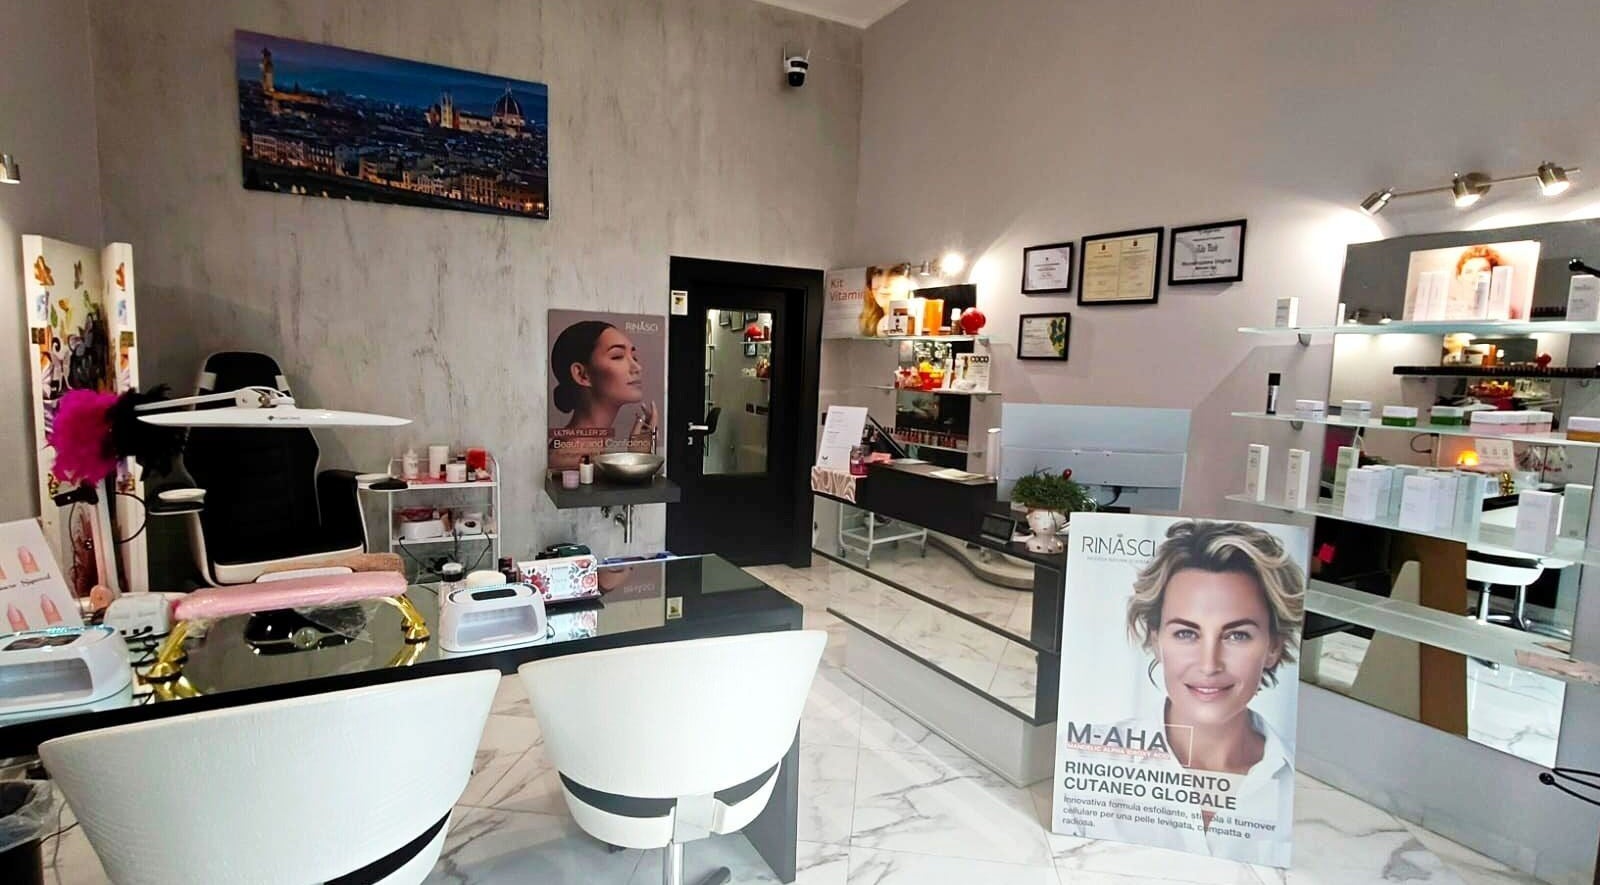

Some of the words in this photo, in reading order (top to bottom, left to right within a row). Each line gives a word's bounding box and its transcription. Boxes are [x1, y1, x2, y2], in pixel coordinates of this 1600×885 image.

[553, 439, 584, 450] Beauty
[605, 439, 655, 449] Confidenc
[576, 429, 597, 437] FILLER
[1066, 721, 1169, 753] M-AHA
[1065, 761, 1231, 792] RINGIOVANIMENTO
[1063, 776, 1147, 798] CUTANEO
[1151, 786, 1237, 810] GLOBALE
[1063, 795, 1107, 808] Innovativa
[1108, 800, 1141, 812] formula
[1143, 805, 1188, 819] esfoliante,
[1063, 807, 1098, 817] cellulare
[1099, 812, 1115, 820] per
[1116, 813, 1132, 822] una
[1134, 815, 1156, 826] pelle
[1157, 818, 1195, 831] levigata,
